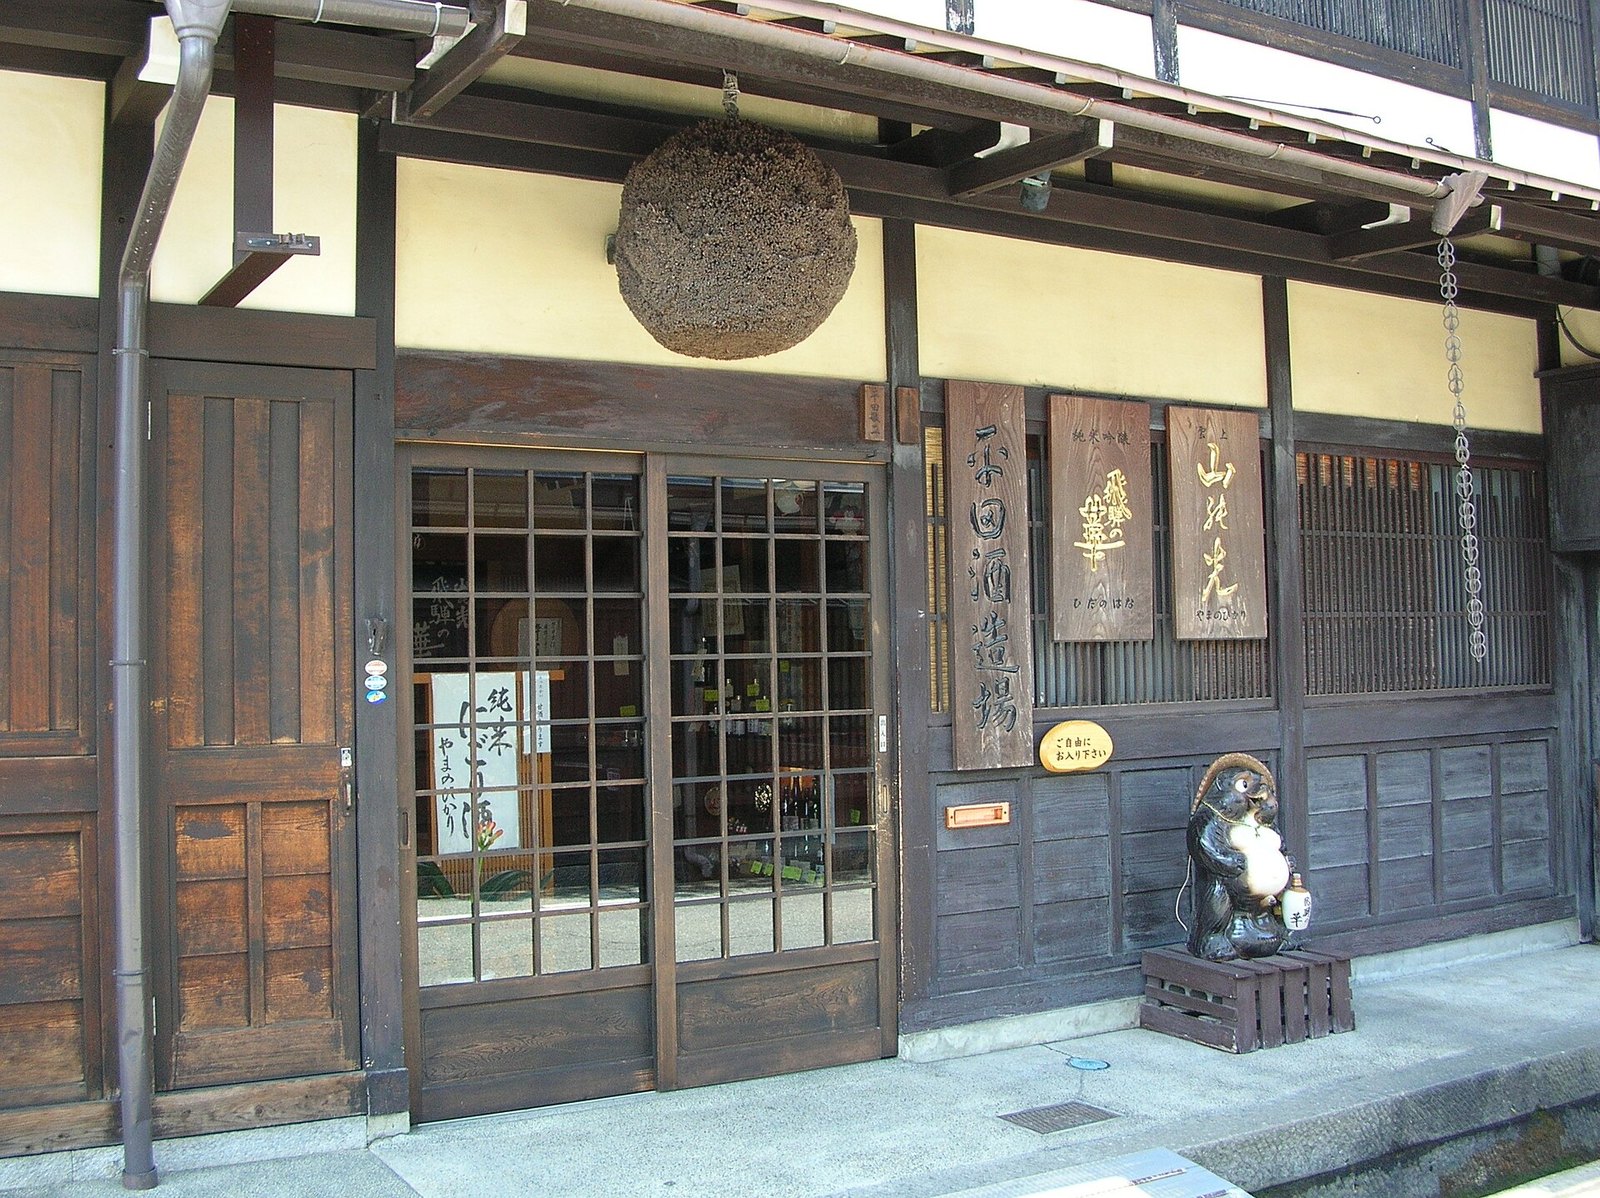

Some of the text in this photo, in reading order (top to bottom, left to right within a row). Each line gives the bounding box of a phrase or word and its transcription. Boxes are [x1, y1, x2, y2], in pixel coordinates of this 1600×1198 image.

[1072, 428, 1131, 445] 純米吟醸
[966, 425, 1019, 733] 平田酒造場
[1073, 598, 1135, 609] ひだのはな
[1195, 609, 1247, 622] やまのひかり
[487, 686, 513, 757] 純米
[1056, 737, 1091, 748] ご自由に
[1056, 749, 1107, 761] お入り下さい
